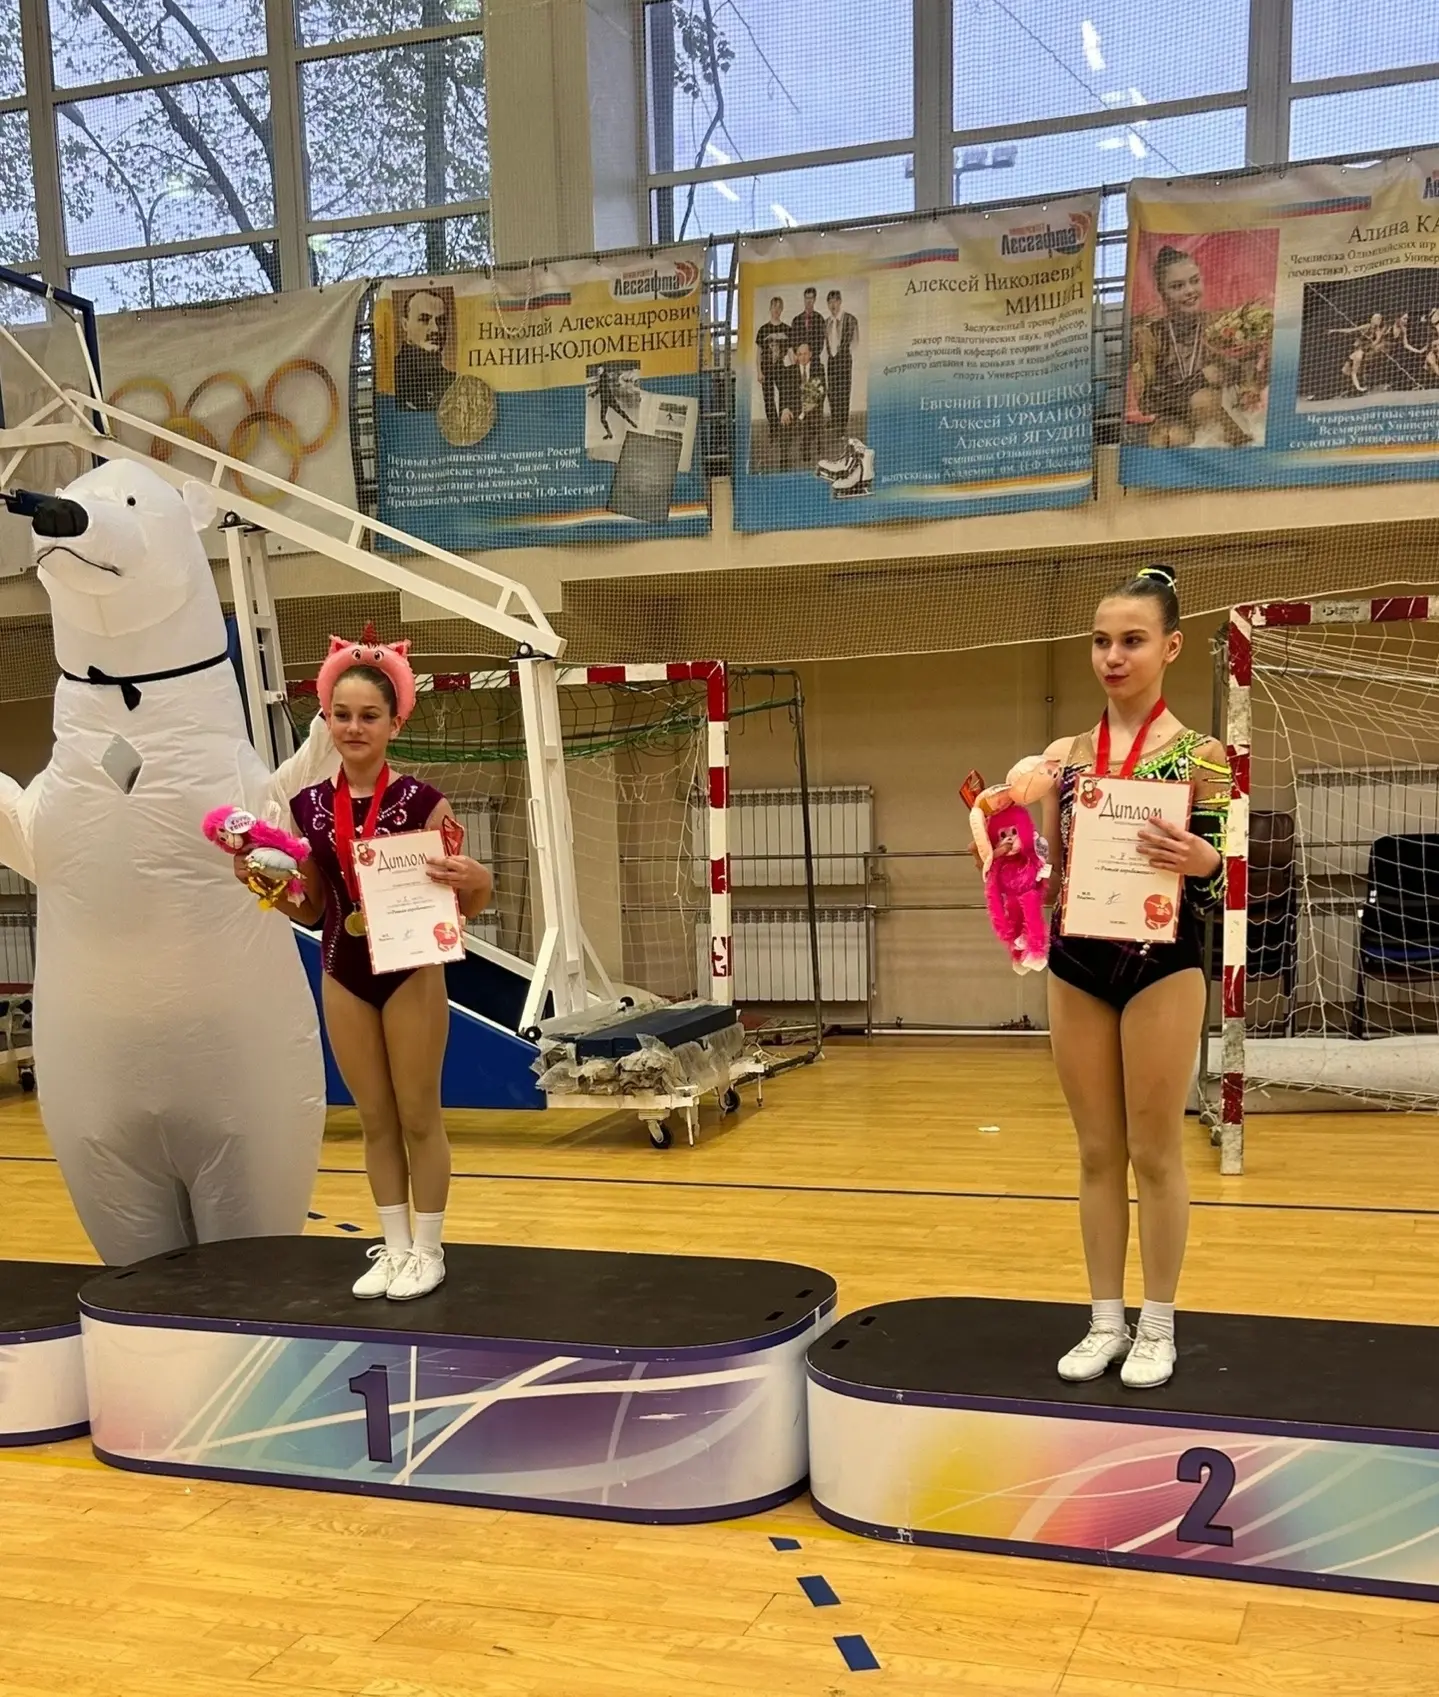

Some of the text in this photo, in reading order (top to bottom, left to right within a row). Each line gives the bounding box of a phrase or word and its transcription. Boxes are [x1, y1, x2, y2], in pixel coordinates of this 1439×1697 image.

[1347, 220, 1409, 243] Алина
[1291, 253, 1345, 264] Чемпионка
[1419, 240, 1436, 251] игр
[1353, 256, 1401, 274] студентка
[614, 269, 680, 300] Лесгафта
[904, 273, 979, 296] Алексей
[478, 304, 700, 340] Николай Александрович
[963, 320, 1025, 334] Заслуженный
[468, 328, 699, 367] ПАНИН-КОЛОМЕНКИН
[912, 335, 942, 346] доктор
[963, 347, 1008, 358] кафедрой
[953, 371, 985, 381] спорта
[920, 382, 1092, 411] Евгений ПЛЮЩЕНКО
[937, 403, 1092, 430] Алексей УРМАНОВ
[954, 432, 1018, 450] Алексей
[500, 450, 544, 460] чемпион
[547, 446, 581, 457] России
[477, 480, 490, 488] на
[1099, 792, 1162, 821] Диплом
[377, 849, 428, 872] Диплом
[349, 1364, 392, 1463] 1
[1176, 1446, 1237, 1547] 2
